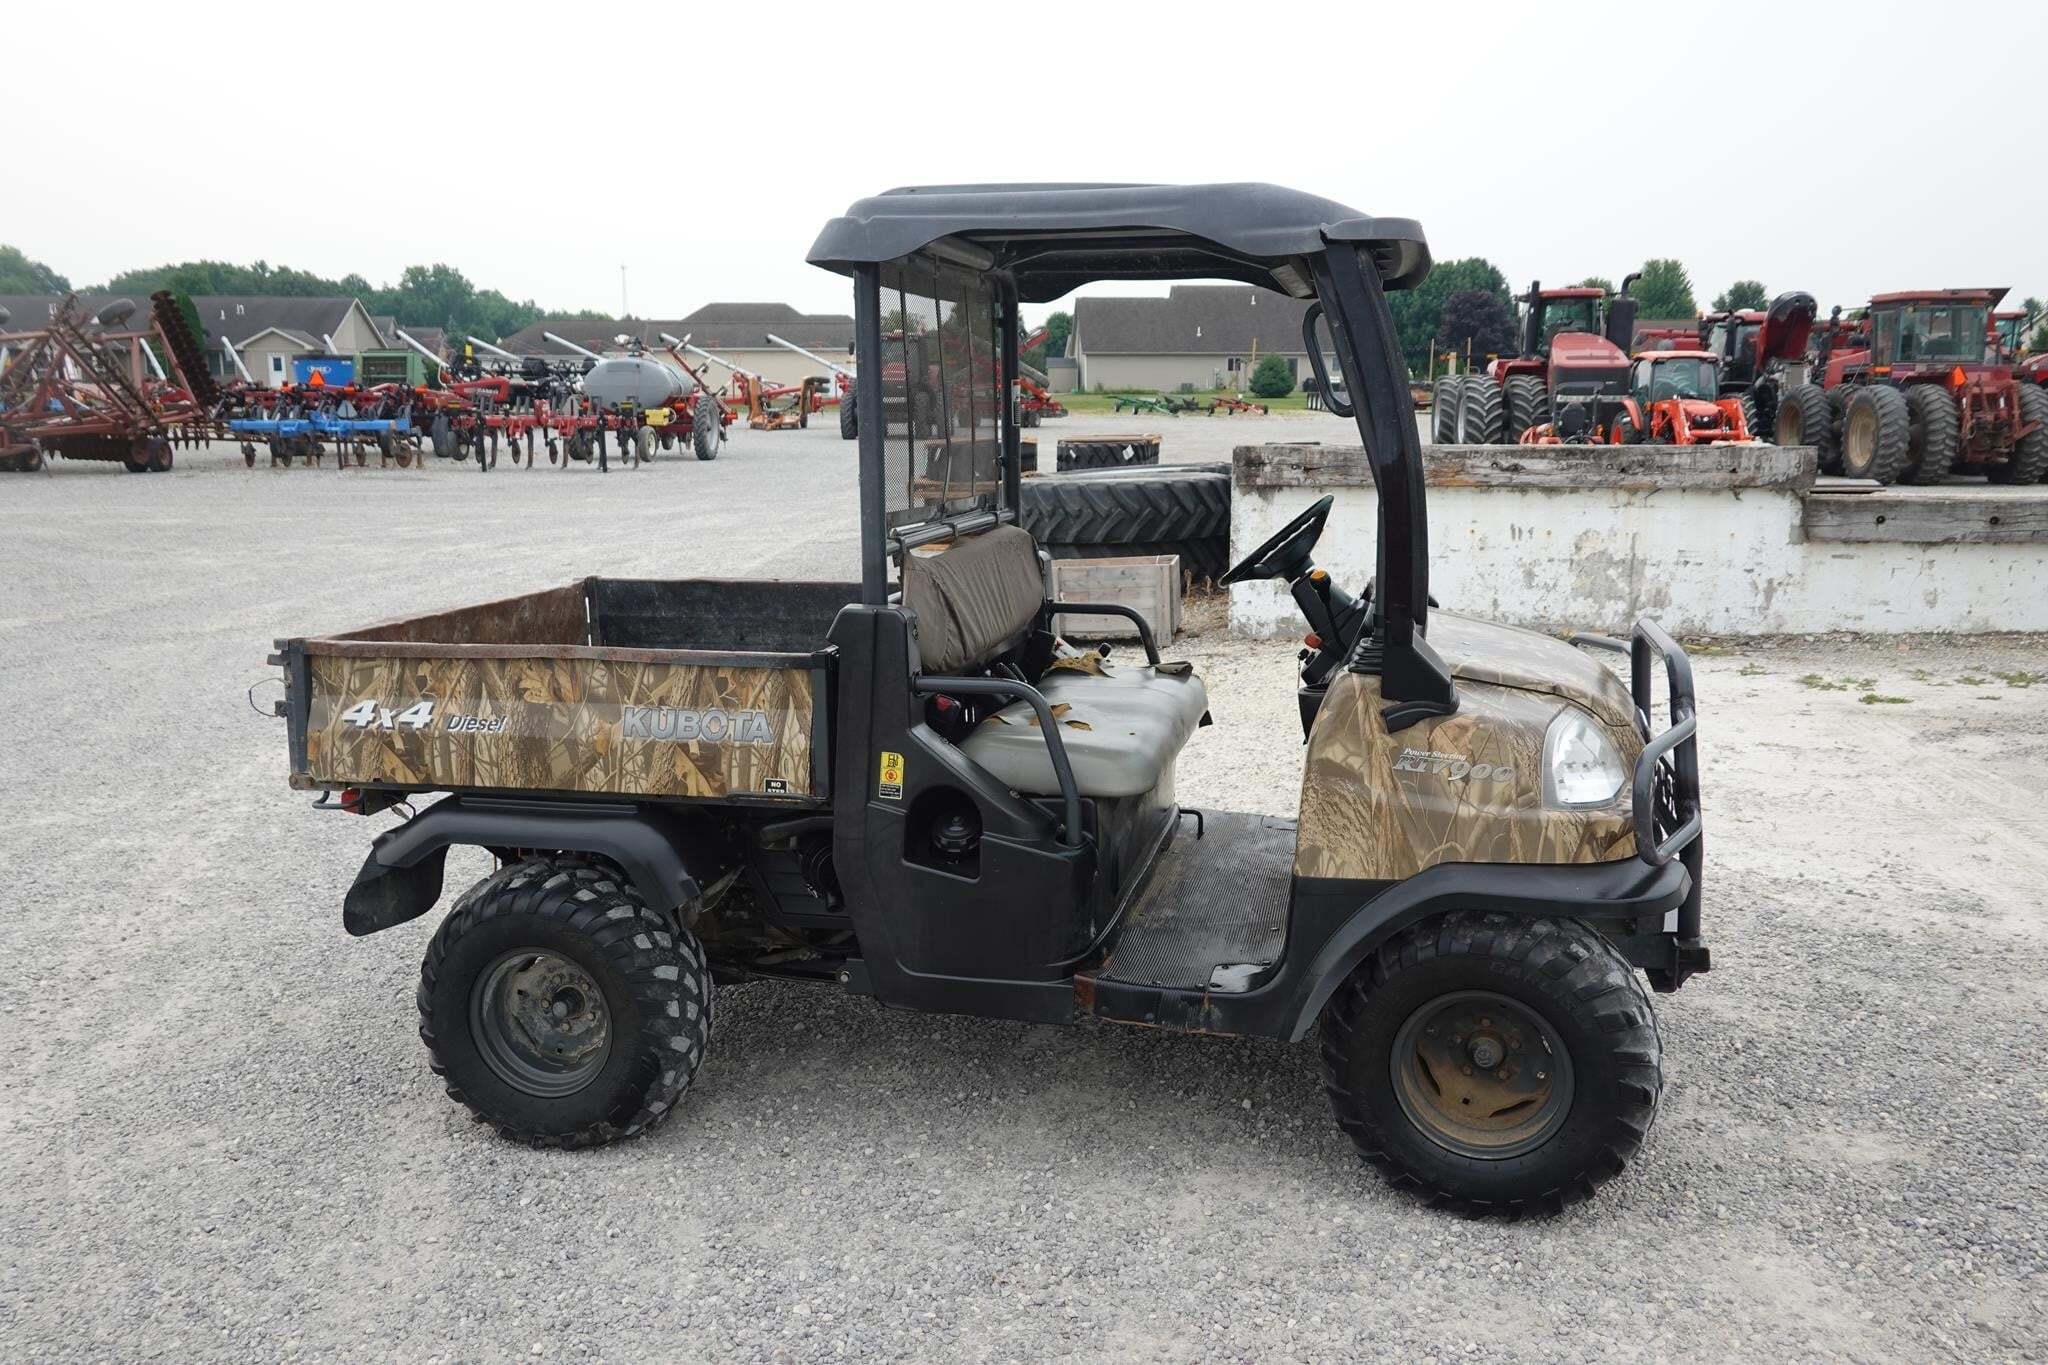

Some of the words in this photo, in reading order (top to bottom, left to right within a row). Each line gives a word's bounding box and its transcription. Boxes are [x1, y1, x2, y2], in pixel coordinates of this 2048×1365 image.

[341, 699, 434, 730] 4x4
[446, 714, 507, 733] Diesel
[622, 705, 774, 745] KUBOTA
[1403, 748, 1430, 757] Power
